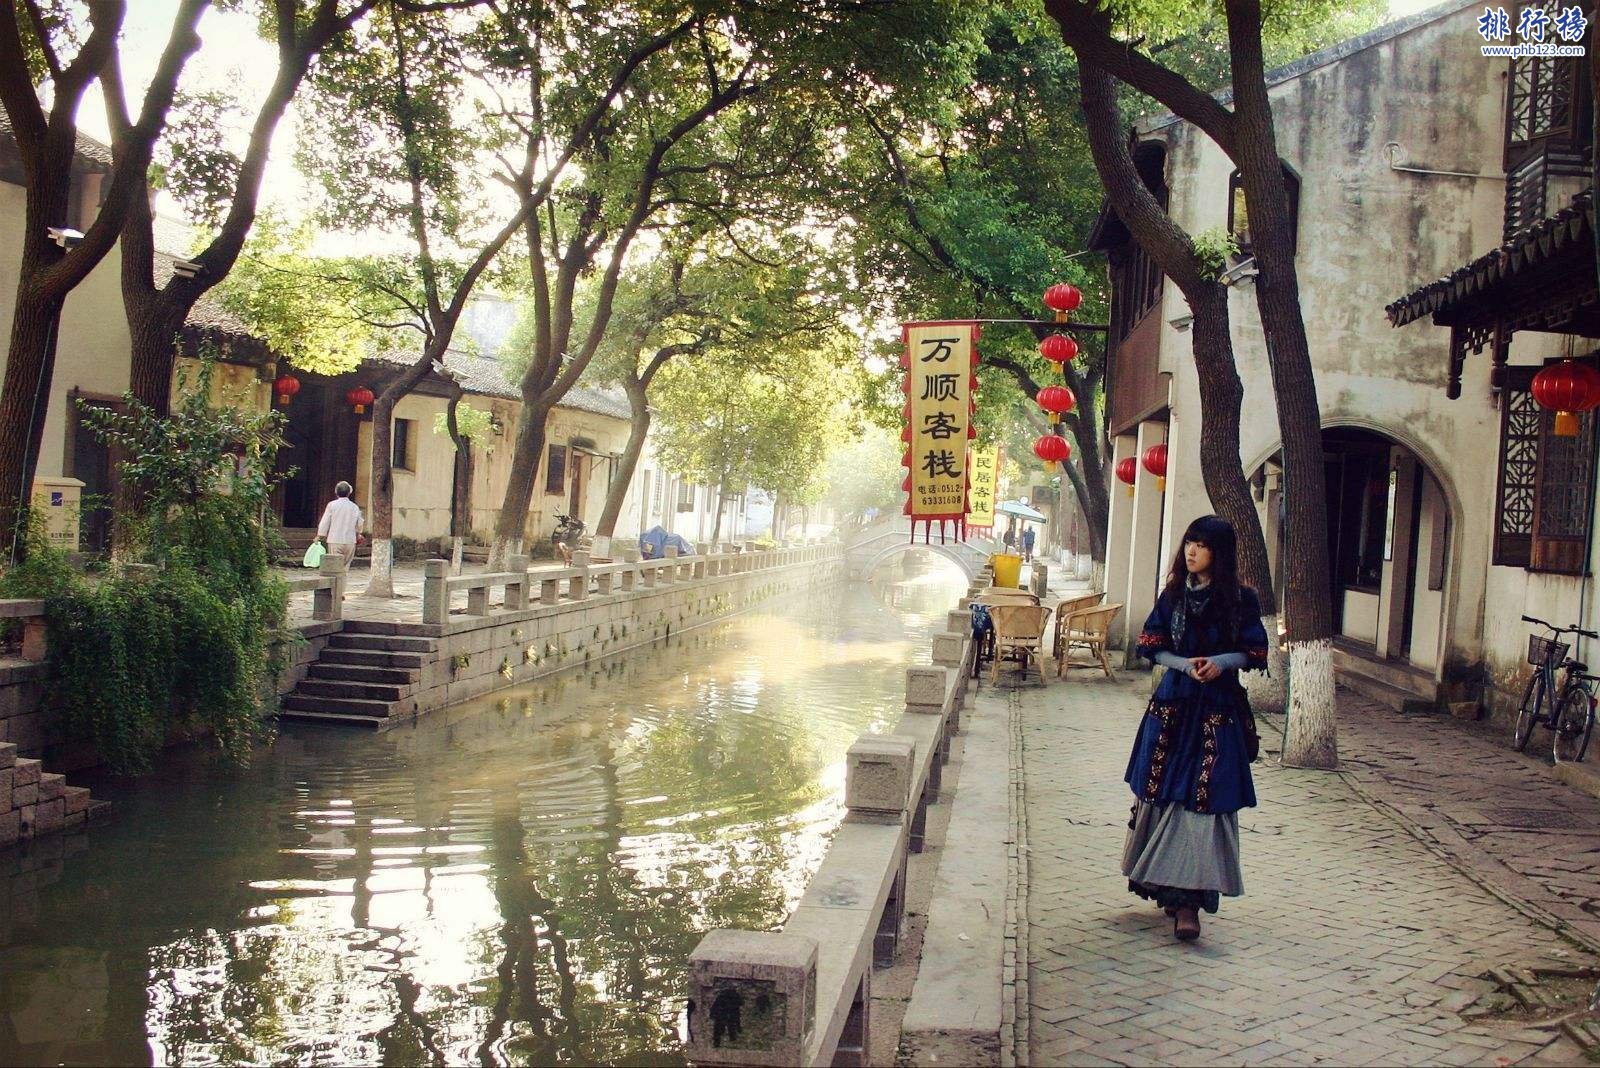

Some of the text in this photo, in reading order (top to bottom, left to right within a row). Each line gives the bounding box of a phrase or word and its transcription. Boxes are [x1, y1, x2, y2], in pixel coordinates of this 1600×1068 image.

[920, 338, 961, 478] 万顺客栈
[922, 495, 961, 505] 63331608
